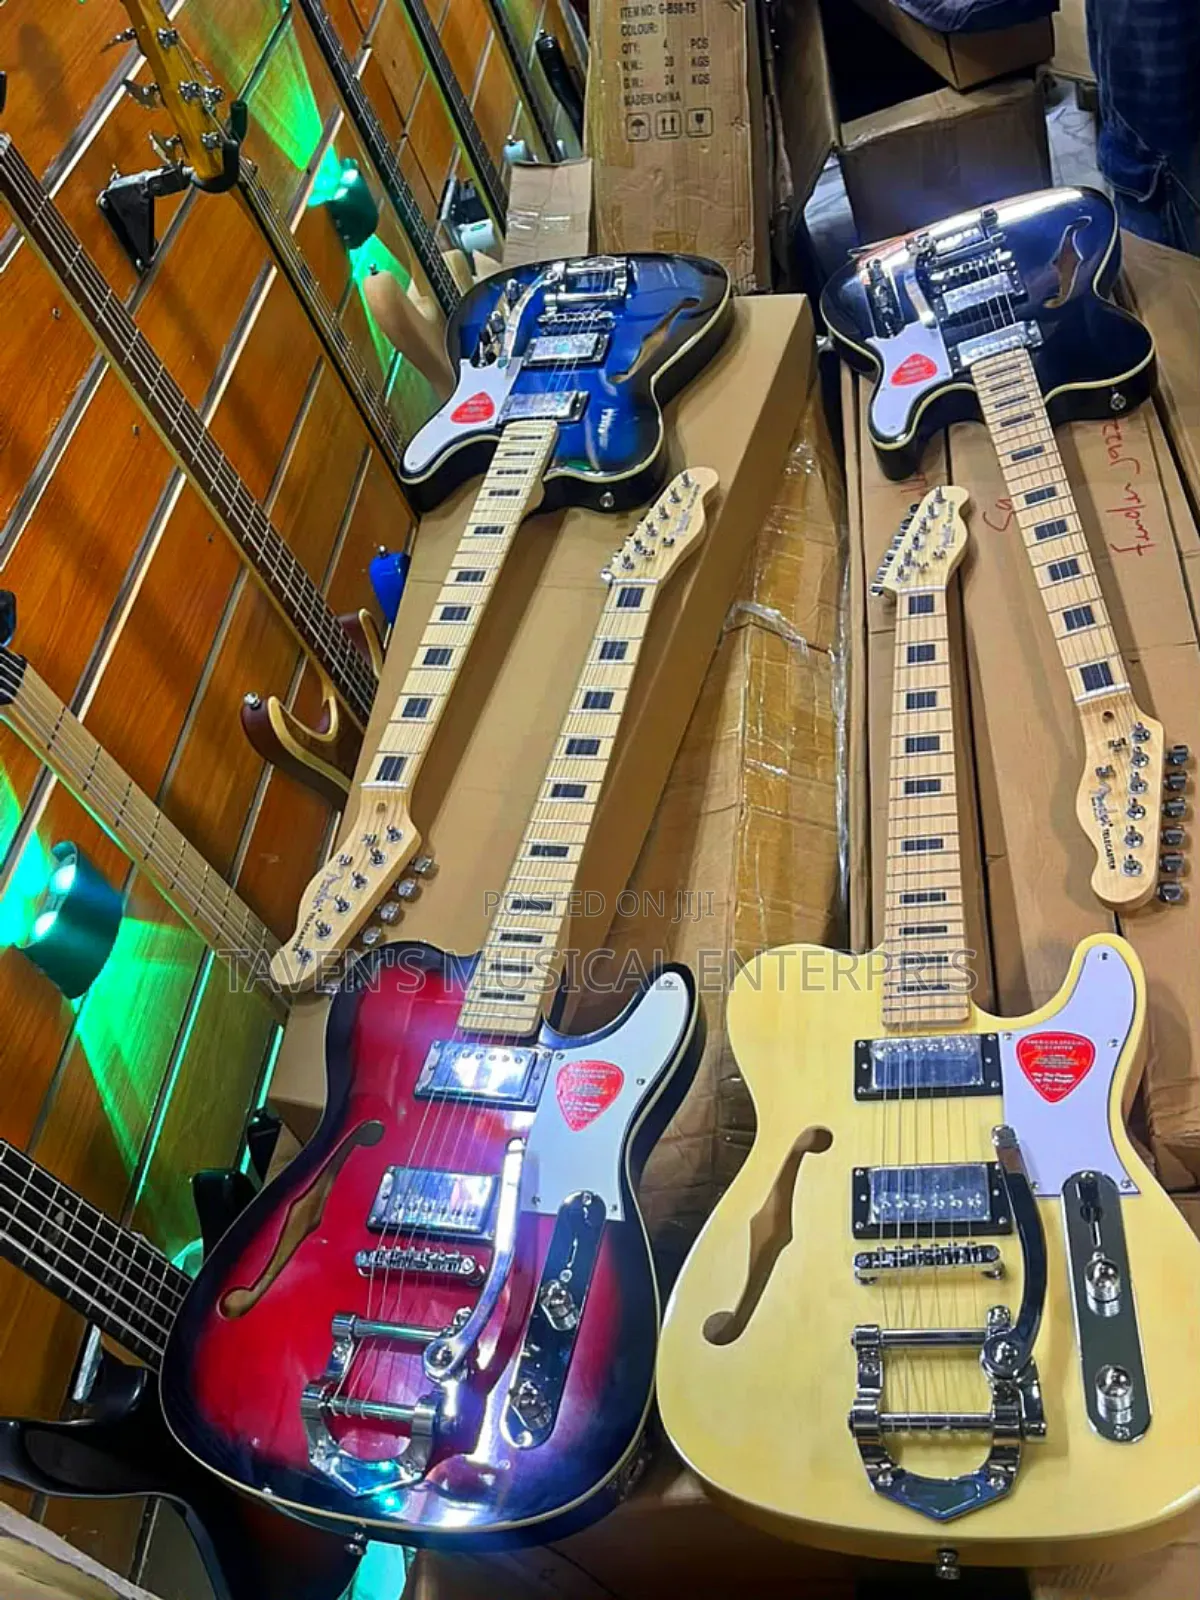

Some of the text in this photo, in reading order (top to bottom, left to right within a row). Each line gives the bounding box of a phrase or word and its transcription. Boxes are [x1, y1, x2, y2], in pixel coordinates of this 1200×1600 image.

[690, 37, 710, 50] PCS
[691, 55, 711, 67] KGS
[691, 73, 711, 85] KGS
